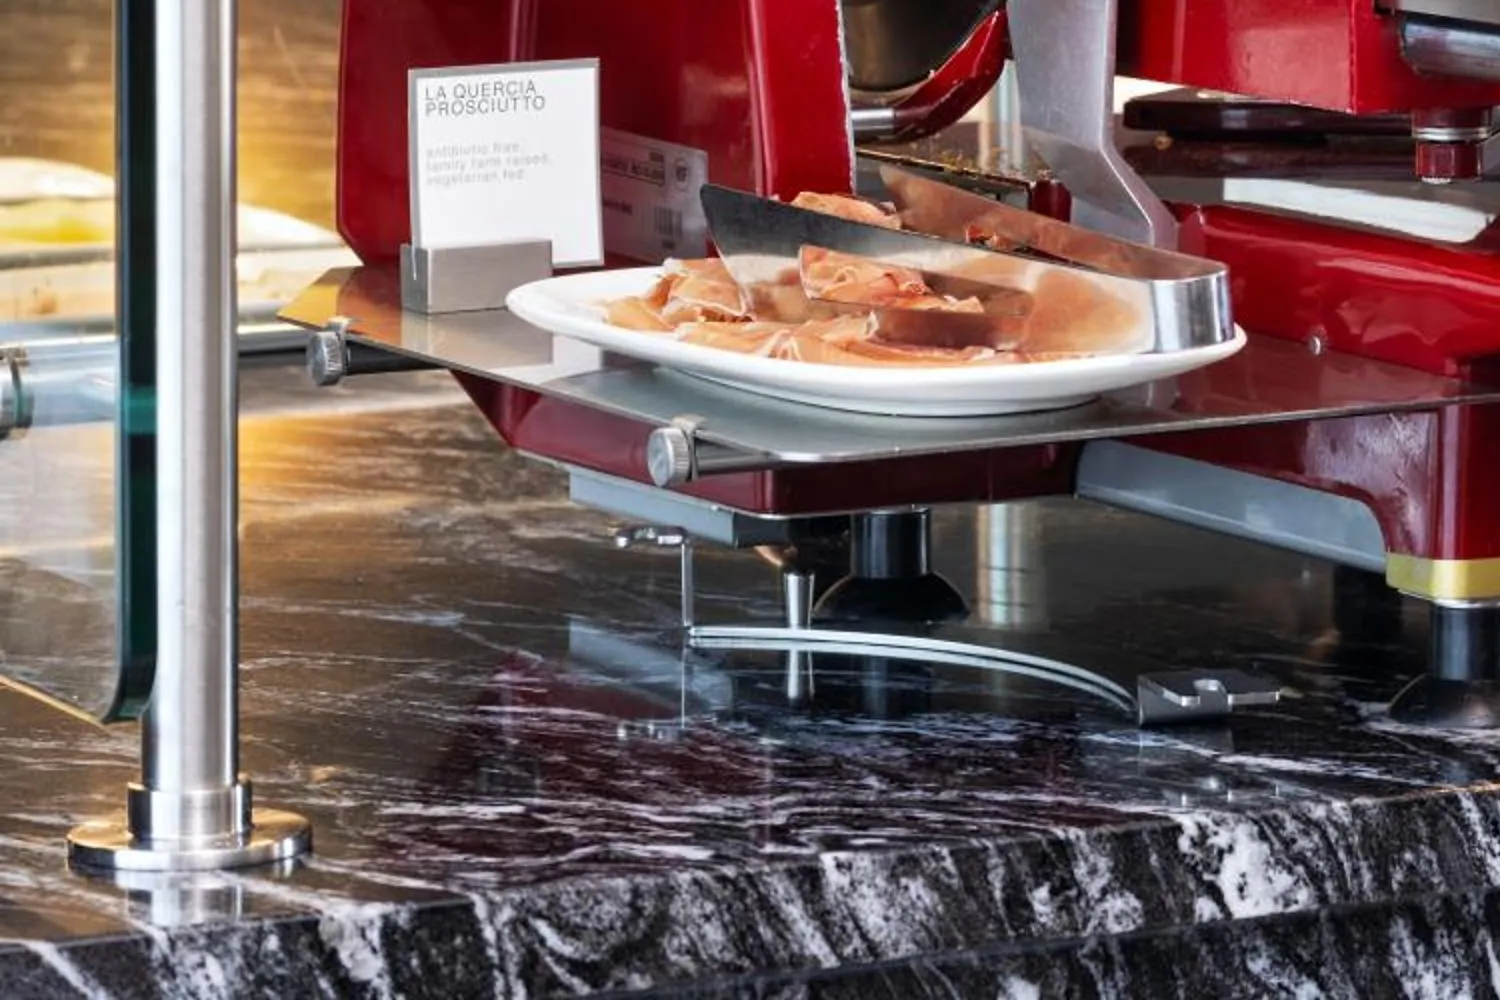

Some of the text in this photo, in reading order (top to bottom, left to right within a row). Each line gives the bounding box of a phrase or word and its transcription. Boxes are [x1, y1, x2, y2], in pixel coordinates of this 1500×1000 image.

[425, 79, 537, 101] LA QUERCIA
[425, 95, 546, 117] PROSCIUTTO
